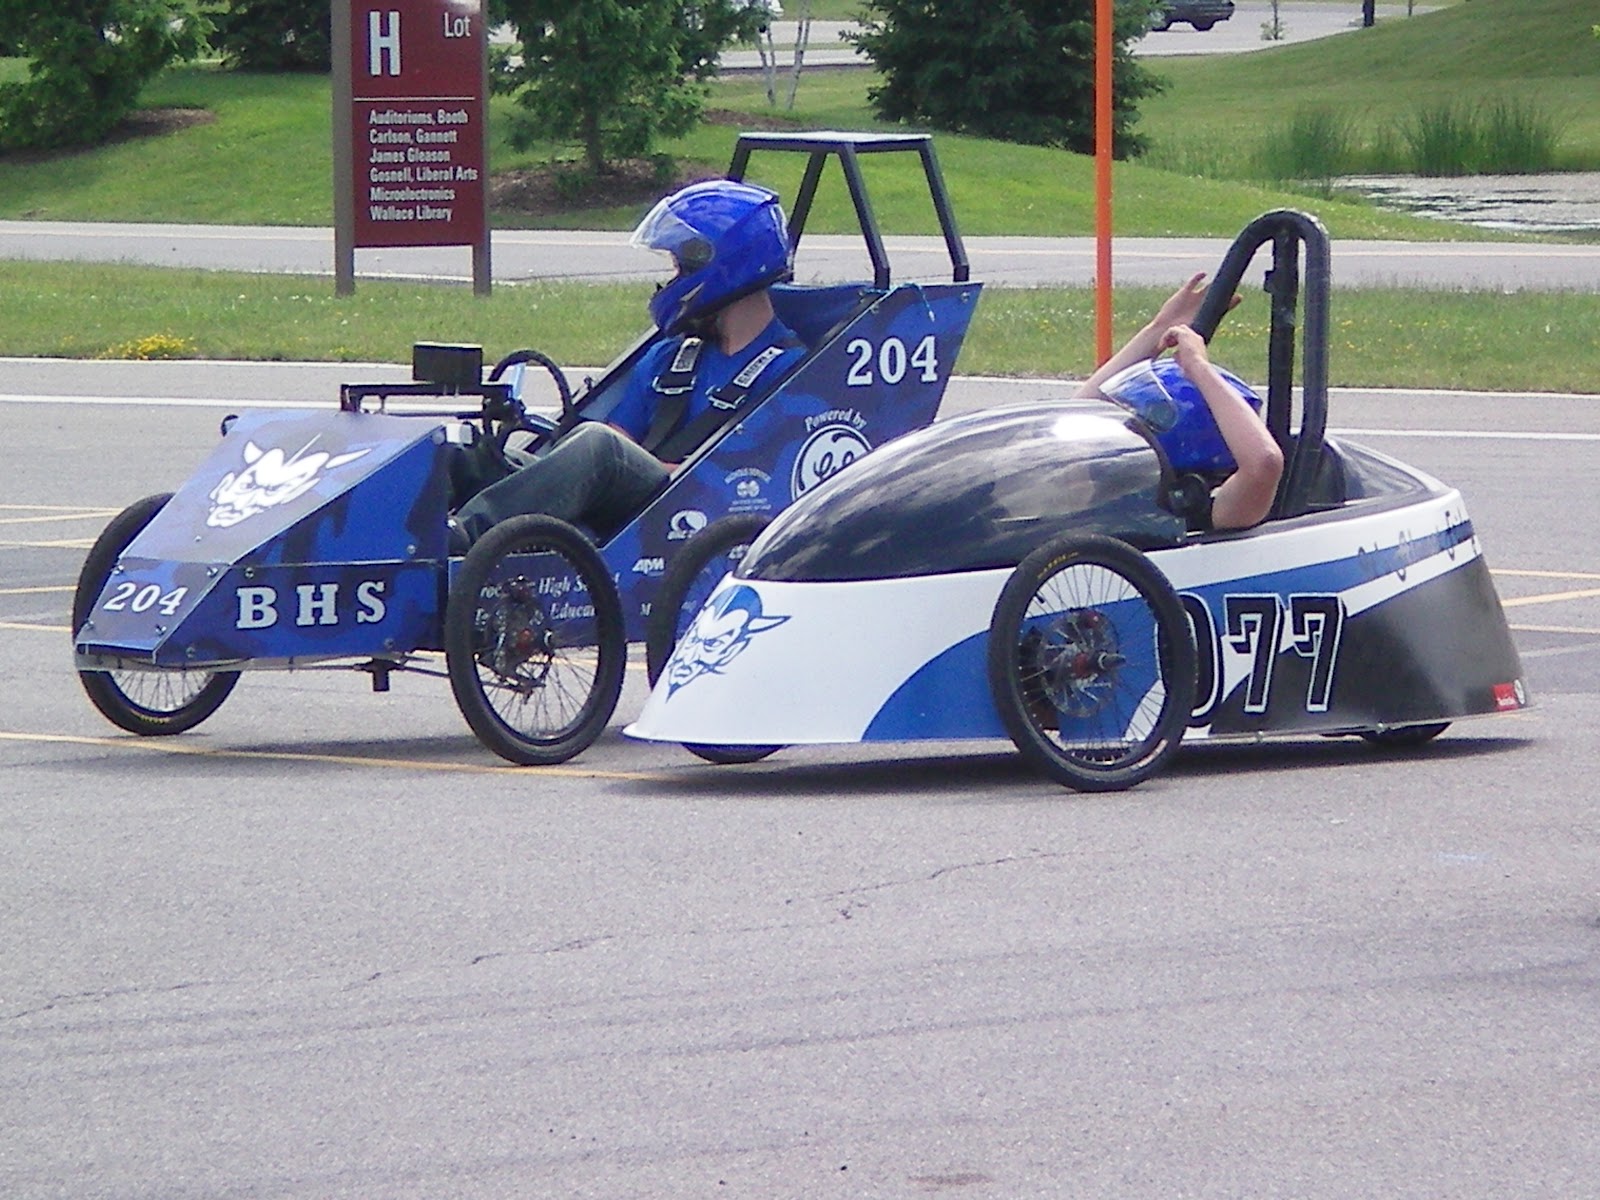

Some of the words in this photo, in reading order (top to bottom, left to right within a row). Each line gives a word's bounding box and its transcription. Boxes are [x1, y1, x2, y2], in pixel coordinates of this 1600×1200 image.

[444, 12, 471, 37] Lot
[369, 11, 400, 76] H
[369, 109, 436, 125] Auditoriums,
[369, 128, 414, 144] Carlson,
[416, 128, 458, 143] Gannett
[369, 147, 405, 162] James
[407, 147, 451, 162] Gleason
[416, 166, 454, 181] Liberal
[456, 165, 479, 180] Arts
[370, 186, 456, 201] Microelectronics
[370, 205, 415, 220] Wallace
[416, 204, 453, 222] Library
[845, 335, 939, 386] 204
[804, 407, 854, 433] Powered
[852, 411, 868, 430] by
[538, 575, 571, 598] High
[102, 582, 189, 616] 204
